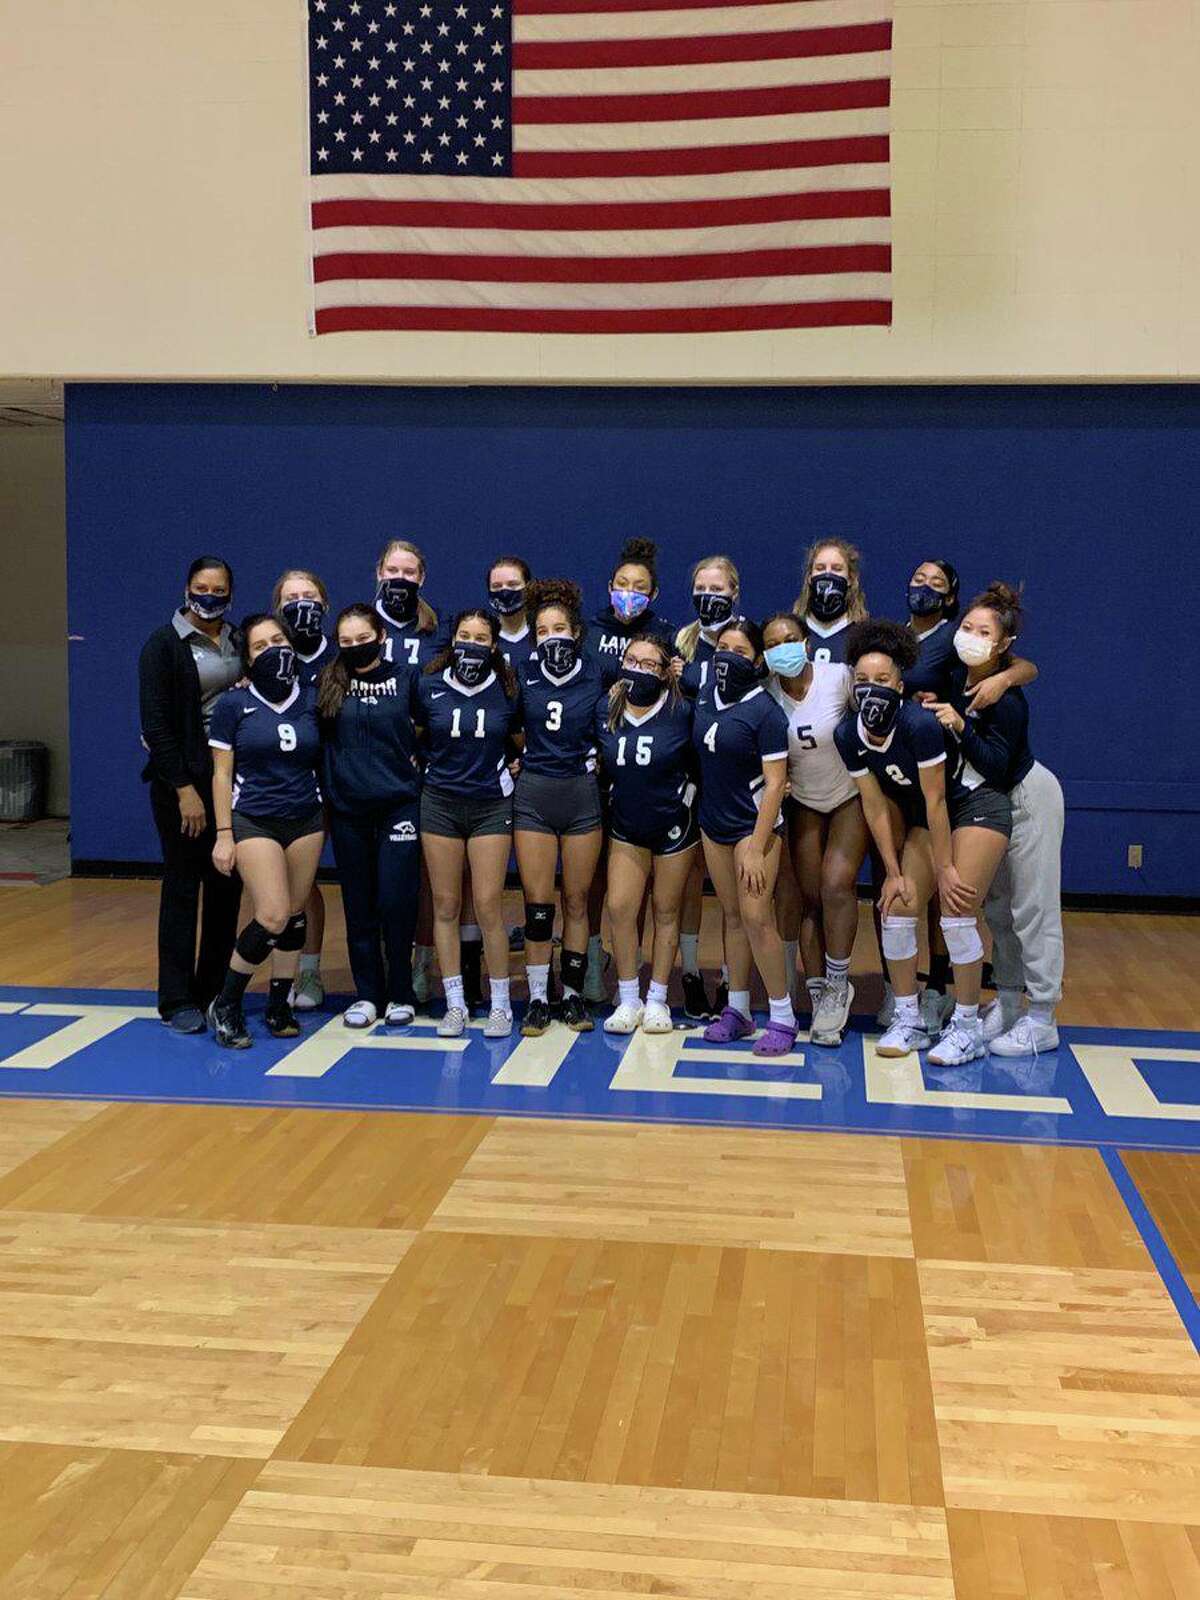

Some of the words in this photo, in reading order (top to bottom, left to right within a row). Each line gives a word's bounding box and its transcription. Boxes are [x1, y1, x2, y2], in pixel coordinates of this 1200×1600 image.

[384, 638, 421, 665] 17
[450, 707, 486, 738] 11
[545, 700, 563, 731] 3
[277, 723, 297, 752] 9
[616, 735, 654, 766] 15
[703, 721, 719, 753] 4
[797, 725, 818, 750] 5
